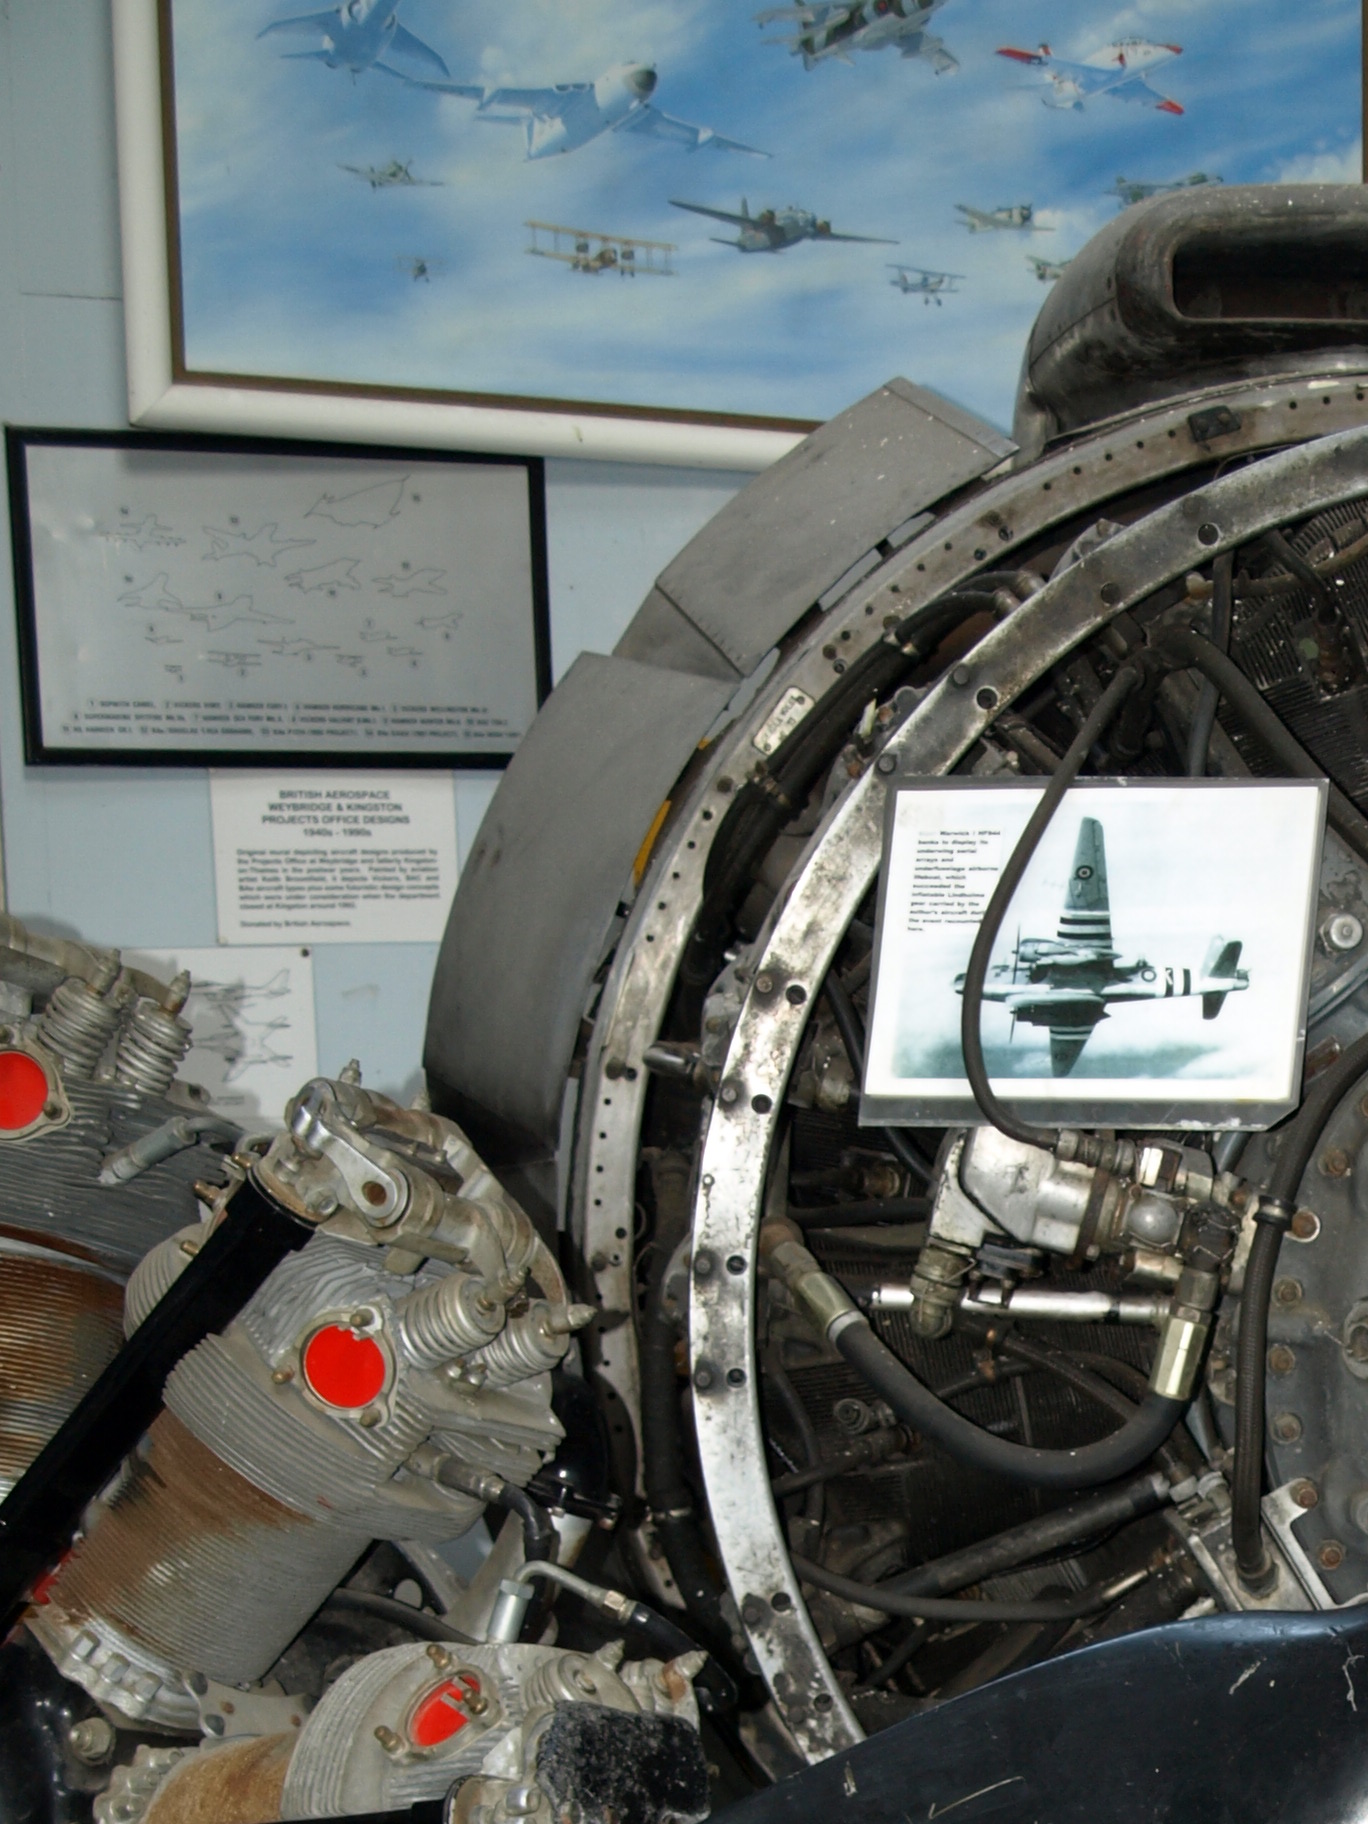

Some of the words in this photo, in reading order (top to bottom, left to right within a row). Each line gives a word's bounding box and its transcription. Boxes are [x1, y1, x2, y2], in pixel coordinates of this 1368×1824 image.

[278, 790, 323, 799] BRITISH
[324, 790, 390, 799] AEROSPACE
[268, 802, 333, 812] WEYBRIDGE
[336, 803, 344, 812] &
[346, 803, 403, 812] KINGSTON
[261, 815, 320, 824] PROJECTS
[321, 815, 360, 824] OFFICE
[362, 815, 410, 824] DESIGNS
[303, 828, 334, 837] 1940s
[342, 828, 372, 837] 1990s
